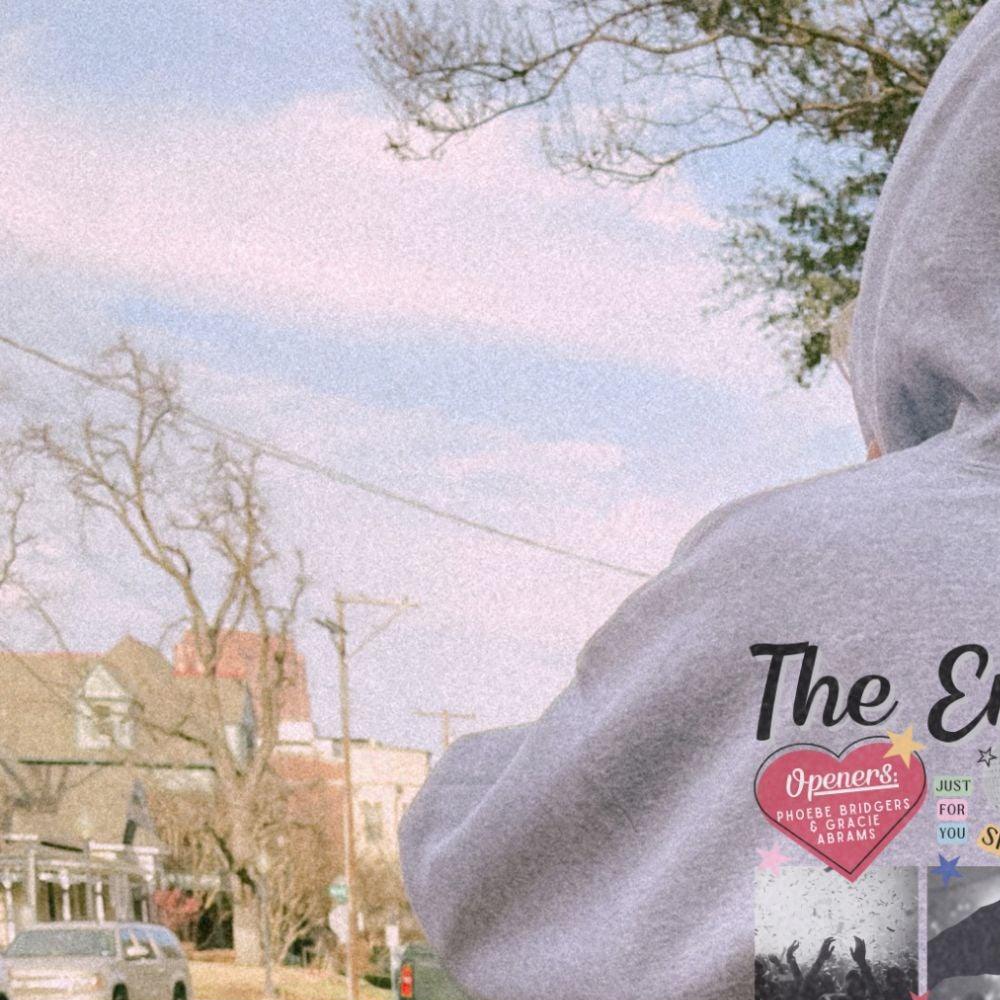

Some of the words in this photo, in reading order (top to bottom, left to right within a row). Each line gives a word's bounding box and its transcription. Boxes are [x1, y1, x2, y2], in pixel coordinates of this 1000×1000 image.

[749, 641, 899, 741] The
[786, 763, 899, 802] Openers:
[936, 780, 971, 791] JUST
[776, 807, 832, 822] PHOEBE
[839, 799, 910, 815] BRIDGERS
[939, 804, 965, 815] FOR
[809, 821, 818, 832] &
[826, 815, 880, 831] GRACIE
[817, 828, 876, 845] ABRAMS
[939, 828, 966, 840] YOU
